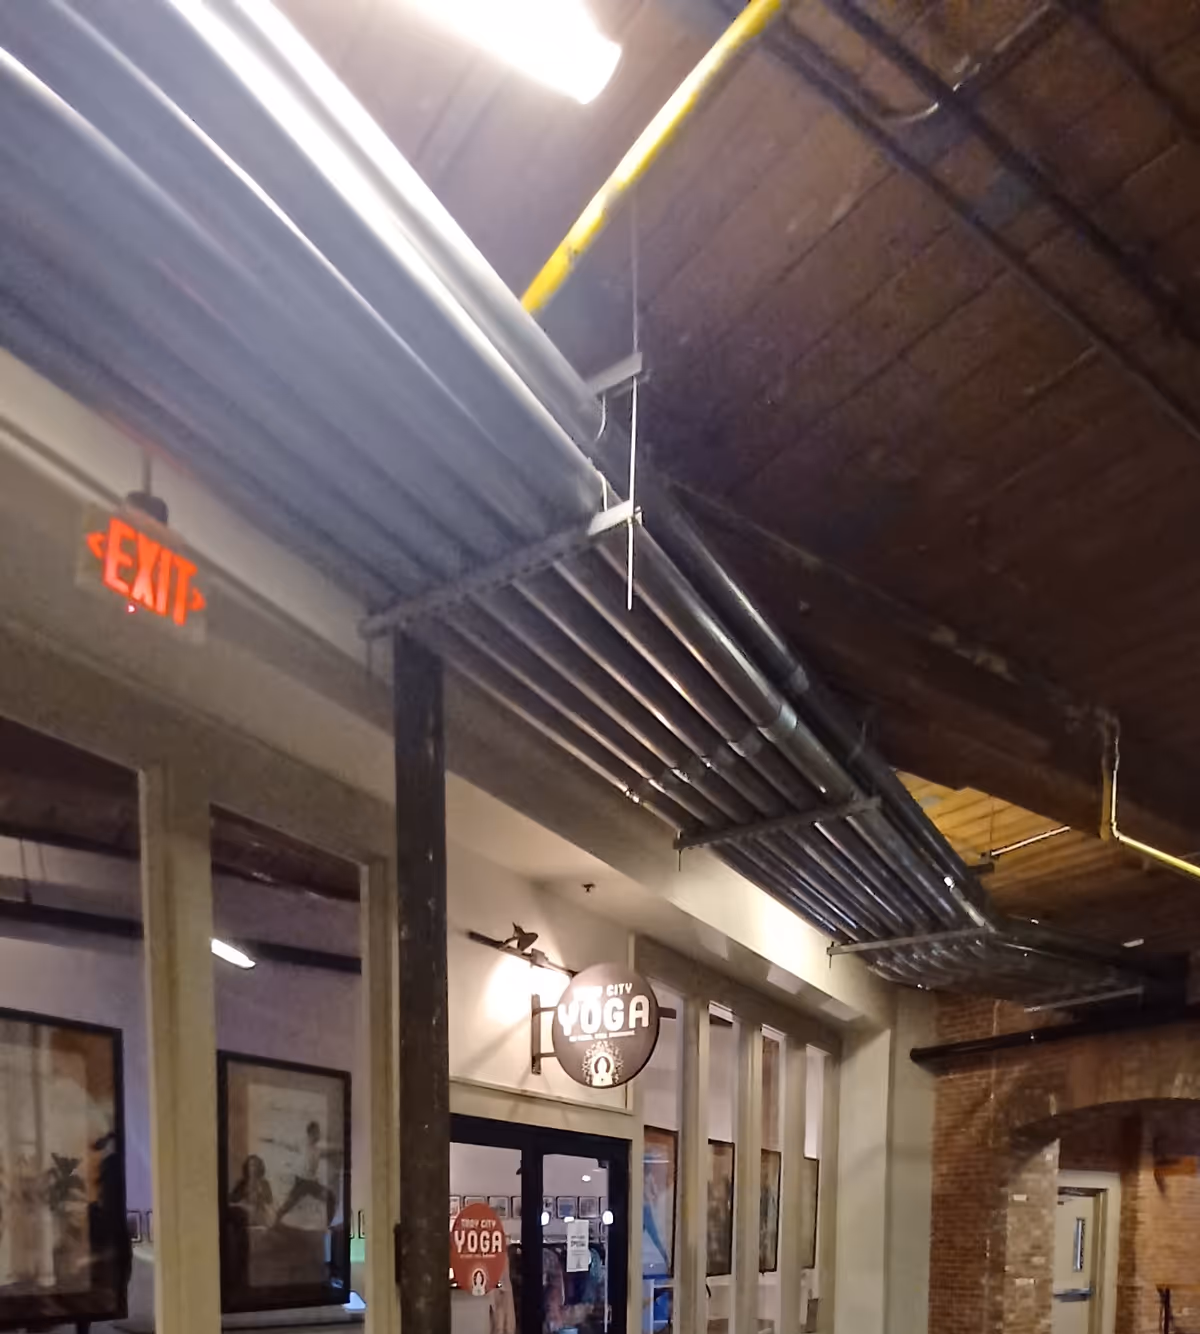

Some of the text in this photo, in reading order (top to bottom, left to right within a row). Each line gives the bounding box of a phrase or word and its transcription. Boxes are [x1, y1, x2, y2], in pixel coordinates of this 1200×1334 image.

[103, 517, 198, 626] EXIT
[606, 982, 633, 997] CITY
[557, 995, 650, 1037] YOGA
[480, 1219, 497, 1229] CITY
[454, 1230, 502, 1253] YOGA
